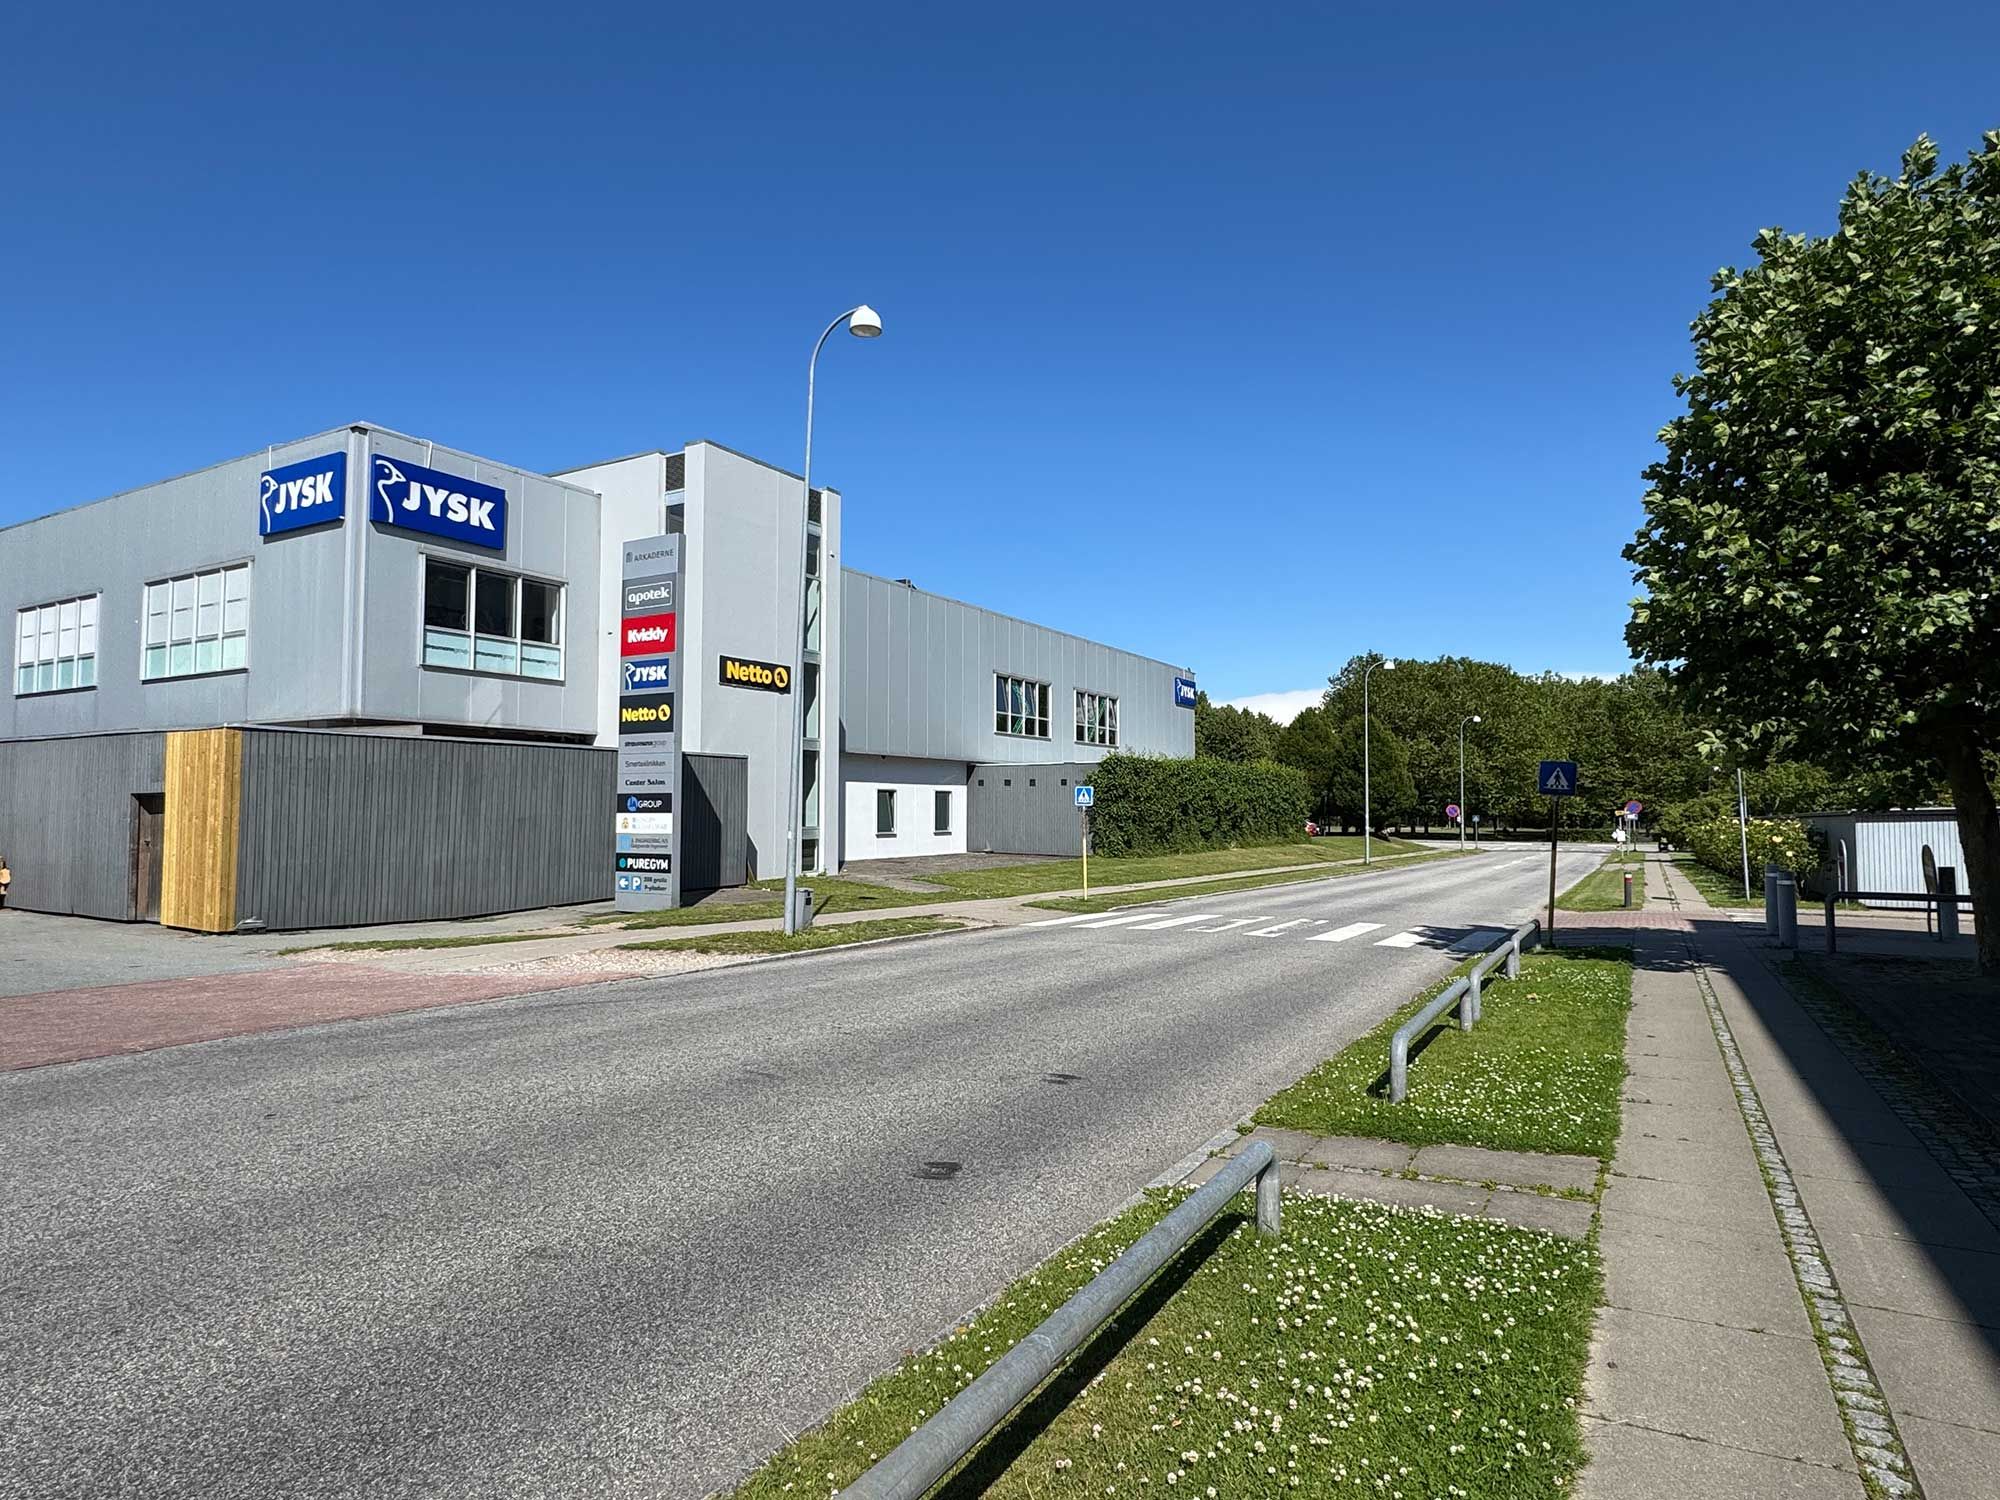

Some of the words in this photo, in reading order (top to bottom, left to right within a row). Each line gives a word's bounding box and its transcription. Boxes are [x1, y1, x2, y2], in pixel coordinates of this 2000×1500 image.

[274, 471, 334, 514] JYSK
[401, 481, 496, 531] JYSK
[634, 548, 674, 562] ARKADERNE
[628, 587, 670, 605] apotek
[627, 626, 668, 643] Kvickly
[633, 665, 667, 682] JYSK
[726, 660, 773, 685] Netto
[1180, 685, 1195, 700] JYSK
[622, 706, 657, 722] Netto
[637, 800, 663, 808] GROUP
[627, 857, 668, 870] PUREGYM
[632, 877, 641, 890] P
